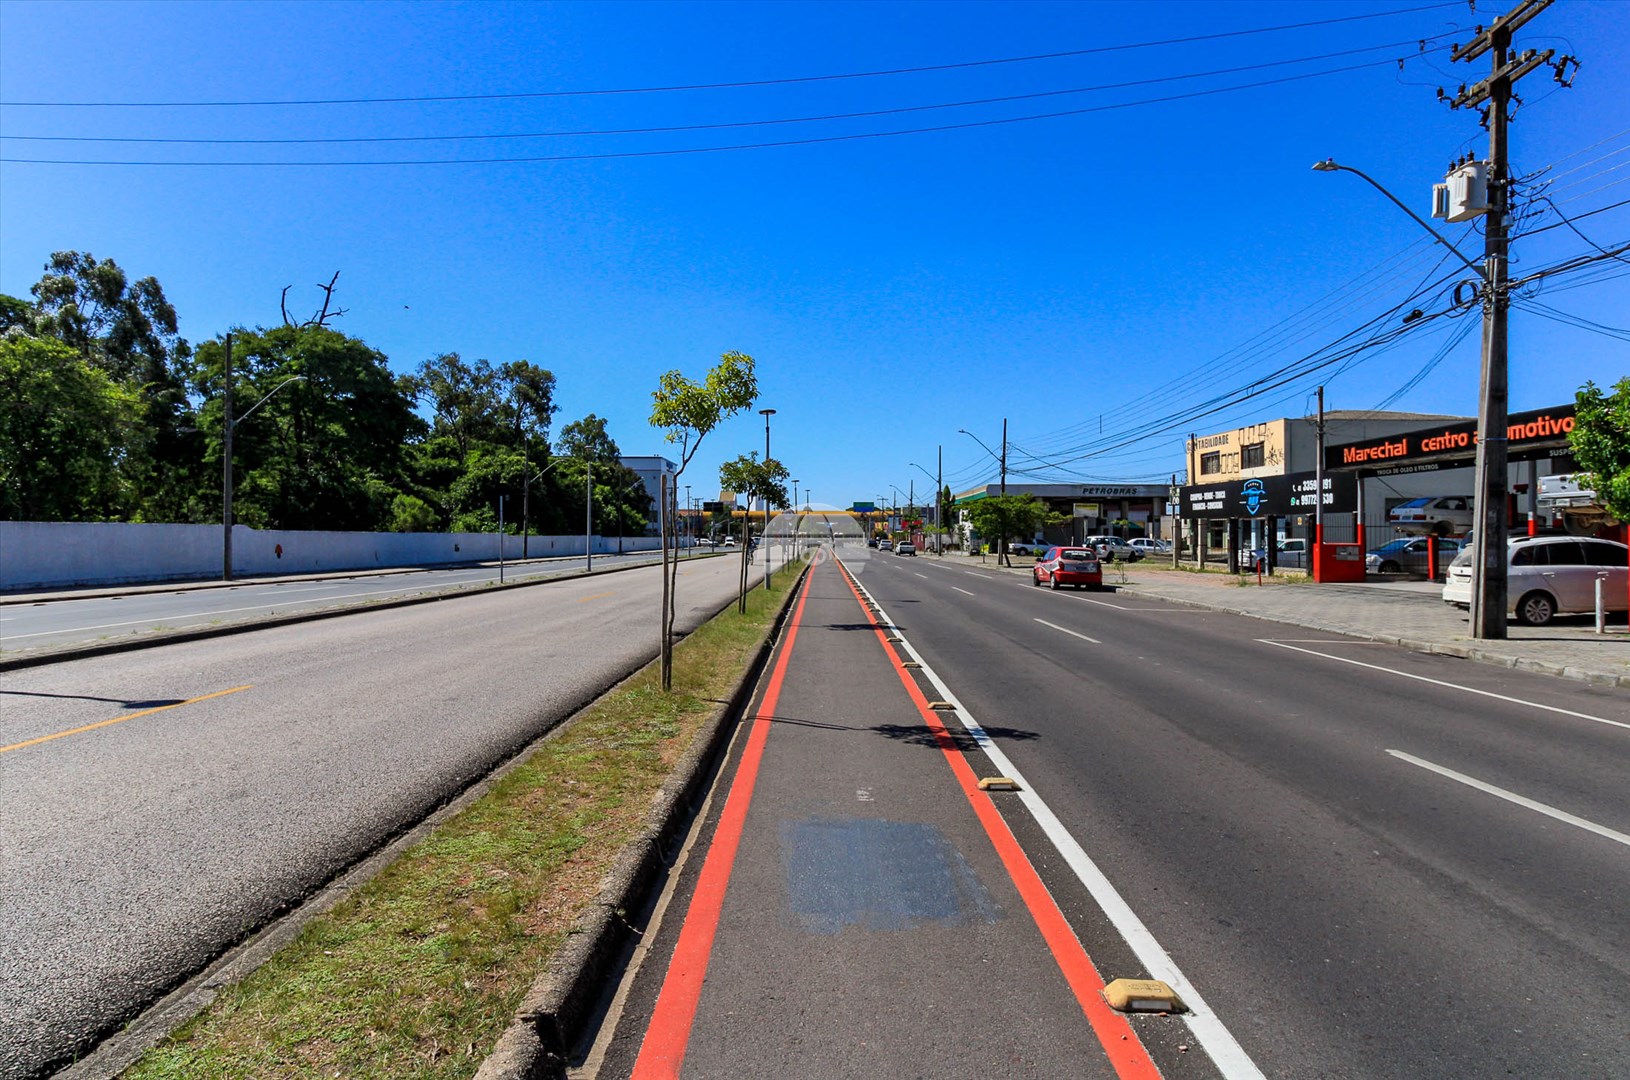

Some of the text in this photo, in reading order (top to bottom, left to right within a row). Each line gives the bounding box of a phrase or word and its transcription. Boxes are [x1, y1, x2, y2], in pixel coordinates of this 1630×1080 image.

[1343, 438, 1408, 464] Marechal
[1421, 431, 1469, 452] centro
[1418, 463, 1439, 471] FILTROS
[1082, 487, 1138, 495] PETROBRAS
